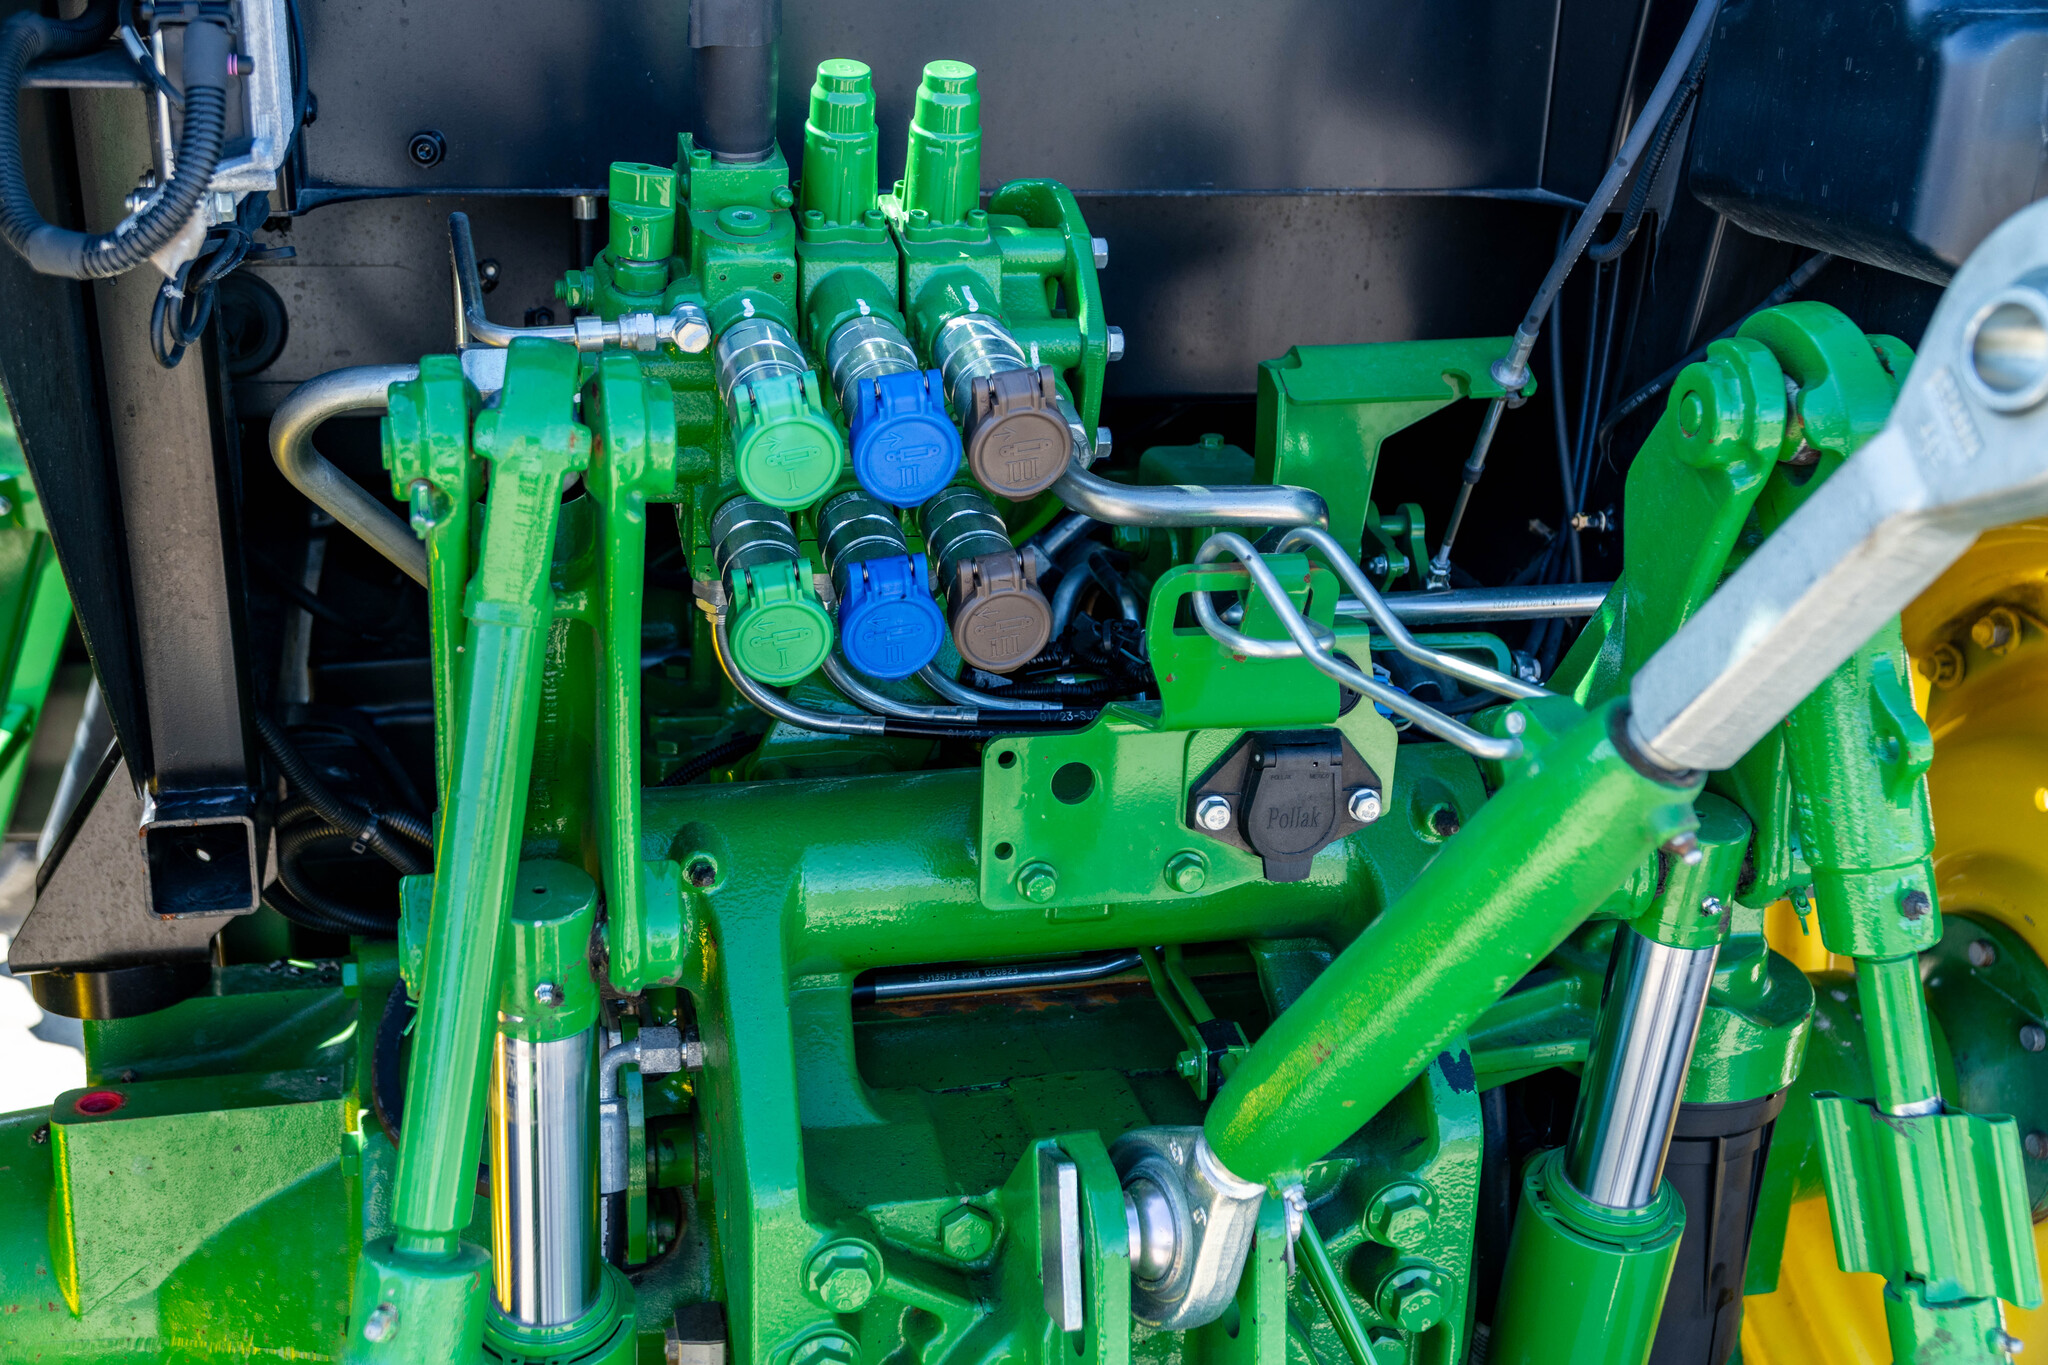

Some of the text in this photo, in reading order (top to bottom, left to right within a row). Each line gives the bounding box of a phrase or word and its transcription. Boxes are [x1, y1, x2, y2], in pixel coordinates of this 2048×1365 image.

[899, 465, 921, 489] II
[1005, 457, 1041, 485] III
[885, 644, 905, 666] II
[1266, 806, 1322, 830] Pollak
